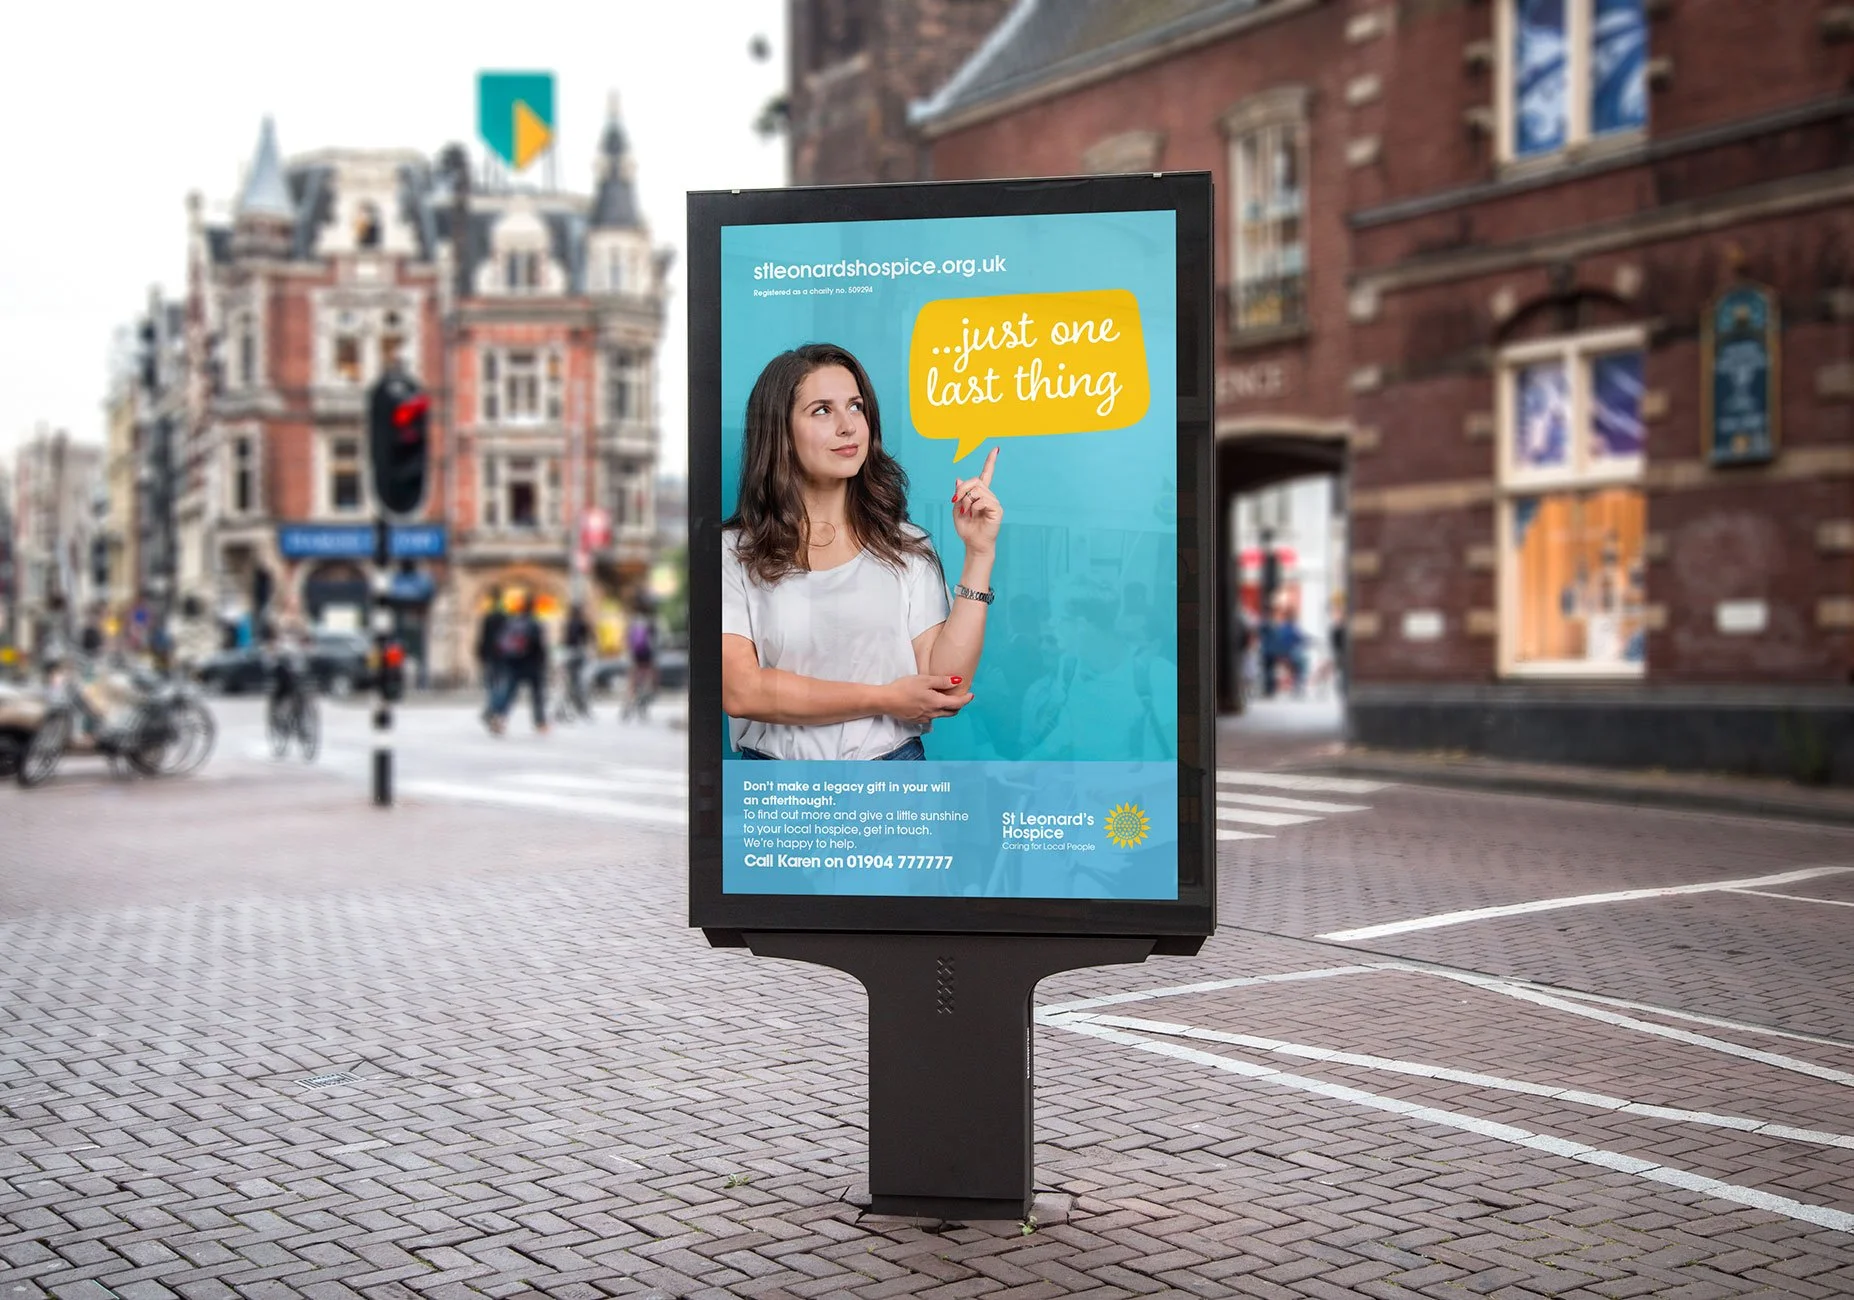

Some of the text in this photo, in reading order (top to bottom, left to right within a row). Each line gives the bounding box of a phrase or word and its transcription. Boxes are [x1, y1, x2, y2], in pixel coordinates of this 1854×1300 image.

[754, 255, 1006, 279] stleonardshospice.org.uk
[754, 288, 791, 298] Registered
[809, 287, 834, 296] charity
[1051, 319, 1120, 345] one
[927, 358, 1122, 416] last thing
[744, 781, 950, 795] Don't make a legacy gift in your will
[744, 795, 835, 809] an afterthought.
[744, 809, 968, 823] To find out more and give a little sunshine
[1003, 812, 1095, 826] St Leonard's
[744, 824, 932, 838] to your local hospice, get in touch.
[1003, 826, 1064, 842] Hospice
[744, 838, 856, 851] We're happy to help.
[1002, 842, 1029, 852] Caring
[1043, 843, 1065, 851] Local
[1067, 843, 1095, 852] People
[744, 854, 952, 870] Call Karen on 01904 777777
